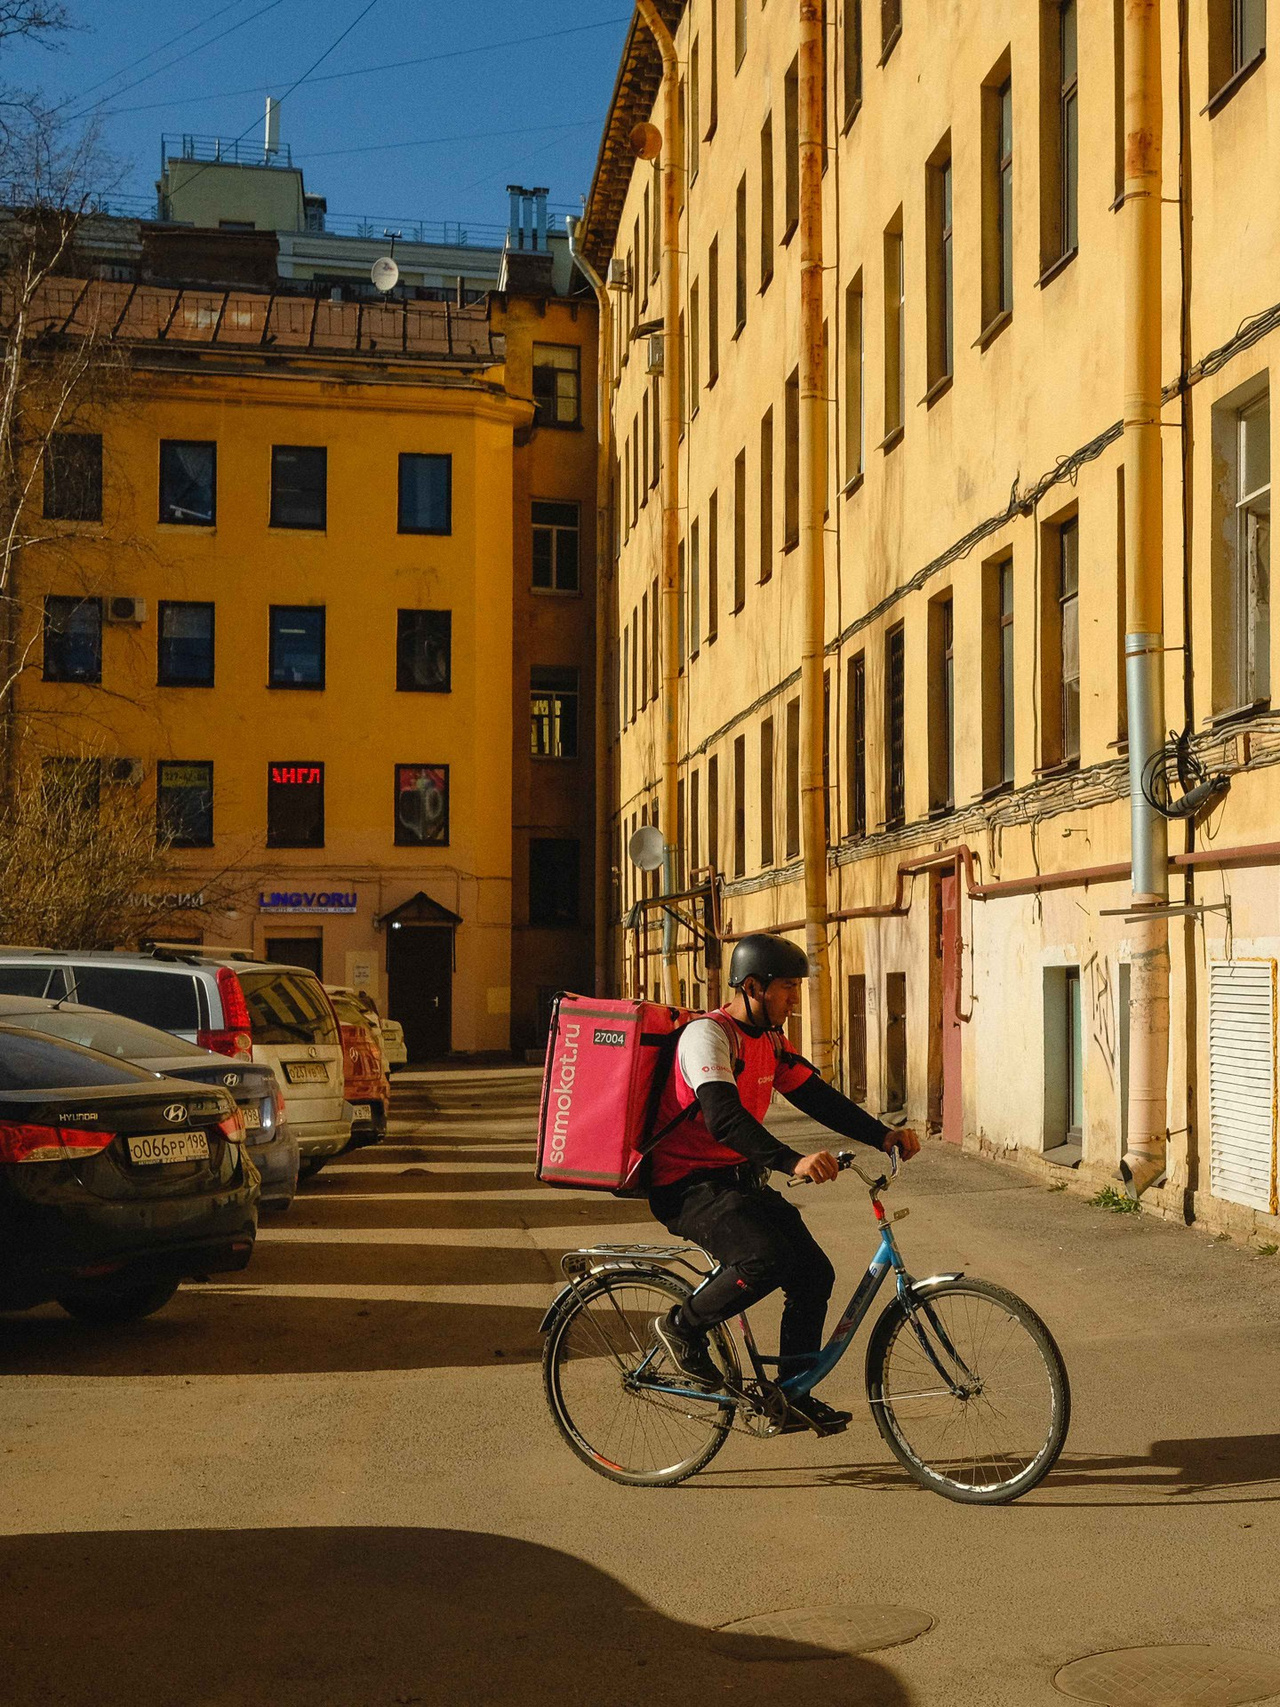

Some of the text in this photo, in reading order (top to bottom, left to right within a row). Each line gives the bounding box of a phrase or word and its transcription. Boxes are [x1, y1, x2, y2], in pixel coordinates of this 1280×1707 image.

[259, 892, 357, 908] LINGVORU
[594, 1032, 625, 1045] 27004
[550, 1023, 581, 1164] samokat.ru
[59, 1112, 99, 1122] HYUNDAI
